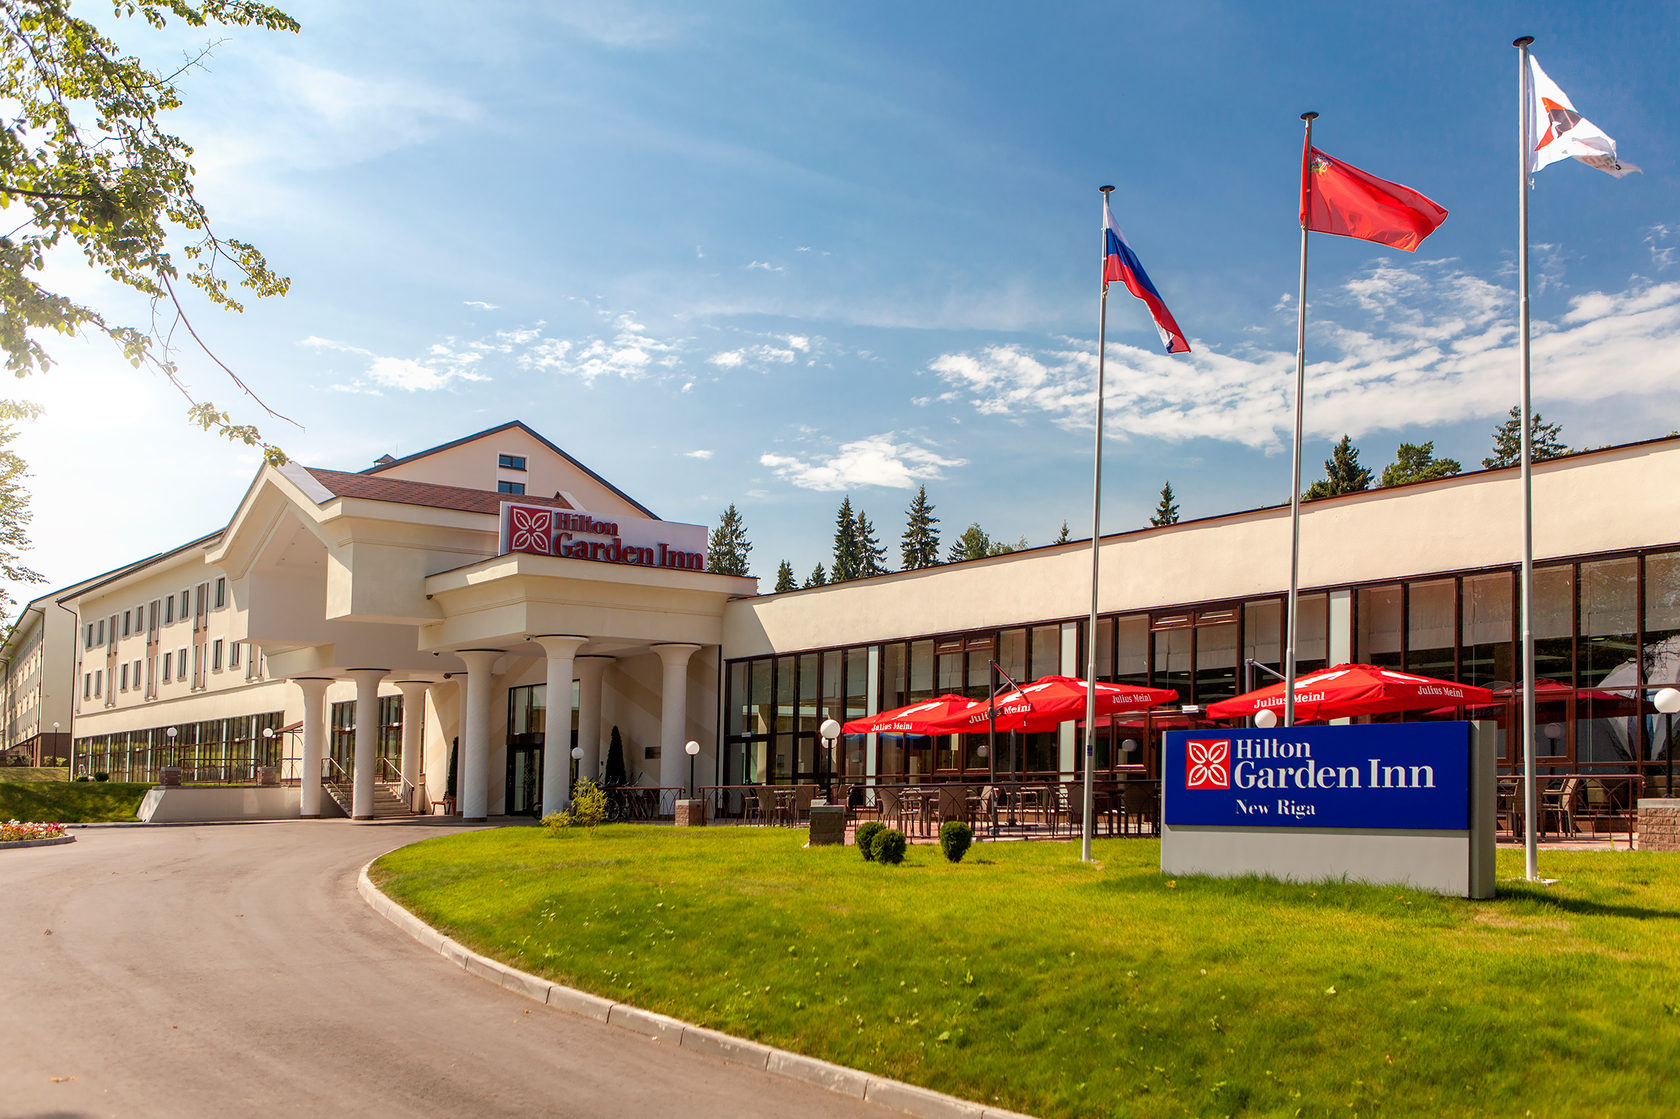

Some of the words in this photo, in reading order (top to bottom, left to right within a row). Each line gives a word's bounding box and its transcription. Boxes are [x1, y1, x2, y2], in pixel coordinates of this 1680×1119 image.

[555, 512, 619, 536] Hilton
[553, 532, 656, 566] Garden
[658, 542, 705, 571] Inn
[1112, 694, 1132, 704] Julius
[1133, 693, 1152, 703] Meinl
[1294, 692, 1325, 703] Meinl
[1417, 686, 1442, 695] Julius
[1443, 687, 1464, 698] Meinl
[969, 708, 1002, 724] Julis
[1003, 703, 1032, 715] Meinl
[871, 723, 892, 731] Julius
[893, 722, 913, 730] Meinl
[1236, 738, 1312, 759] Hilton
[1234, 759, 1362, 790] Garden
[1368, 758, 1436, 789] Inn
[1236, 799, 1270, 815] New
[1277, 799, 1316, 819] Riga
